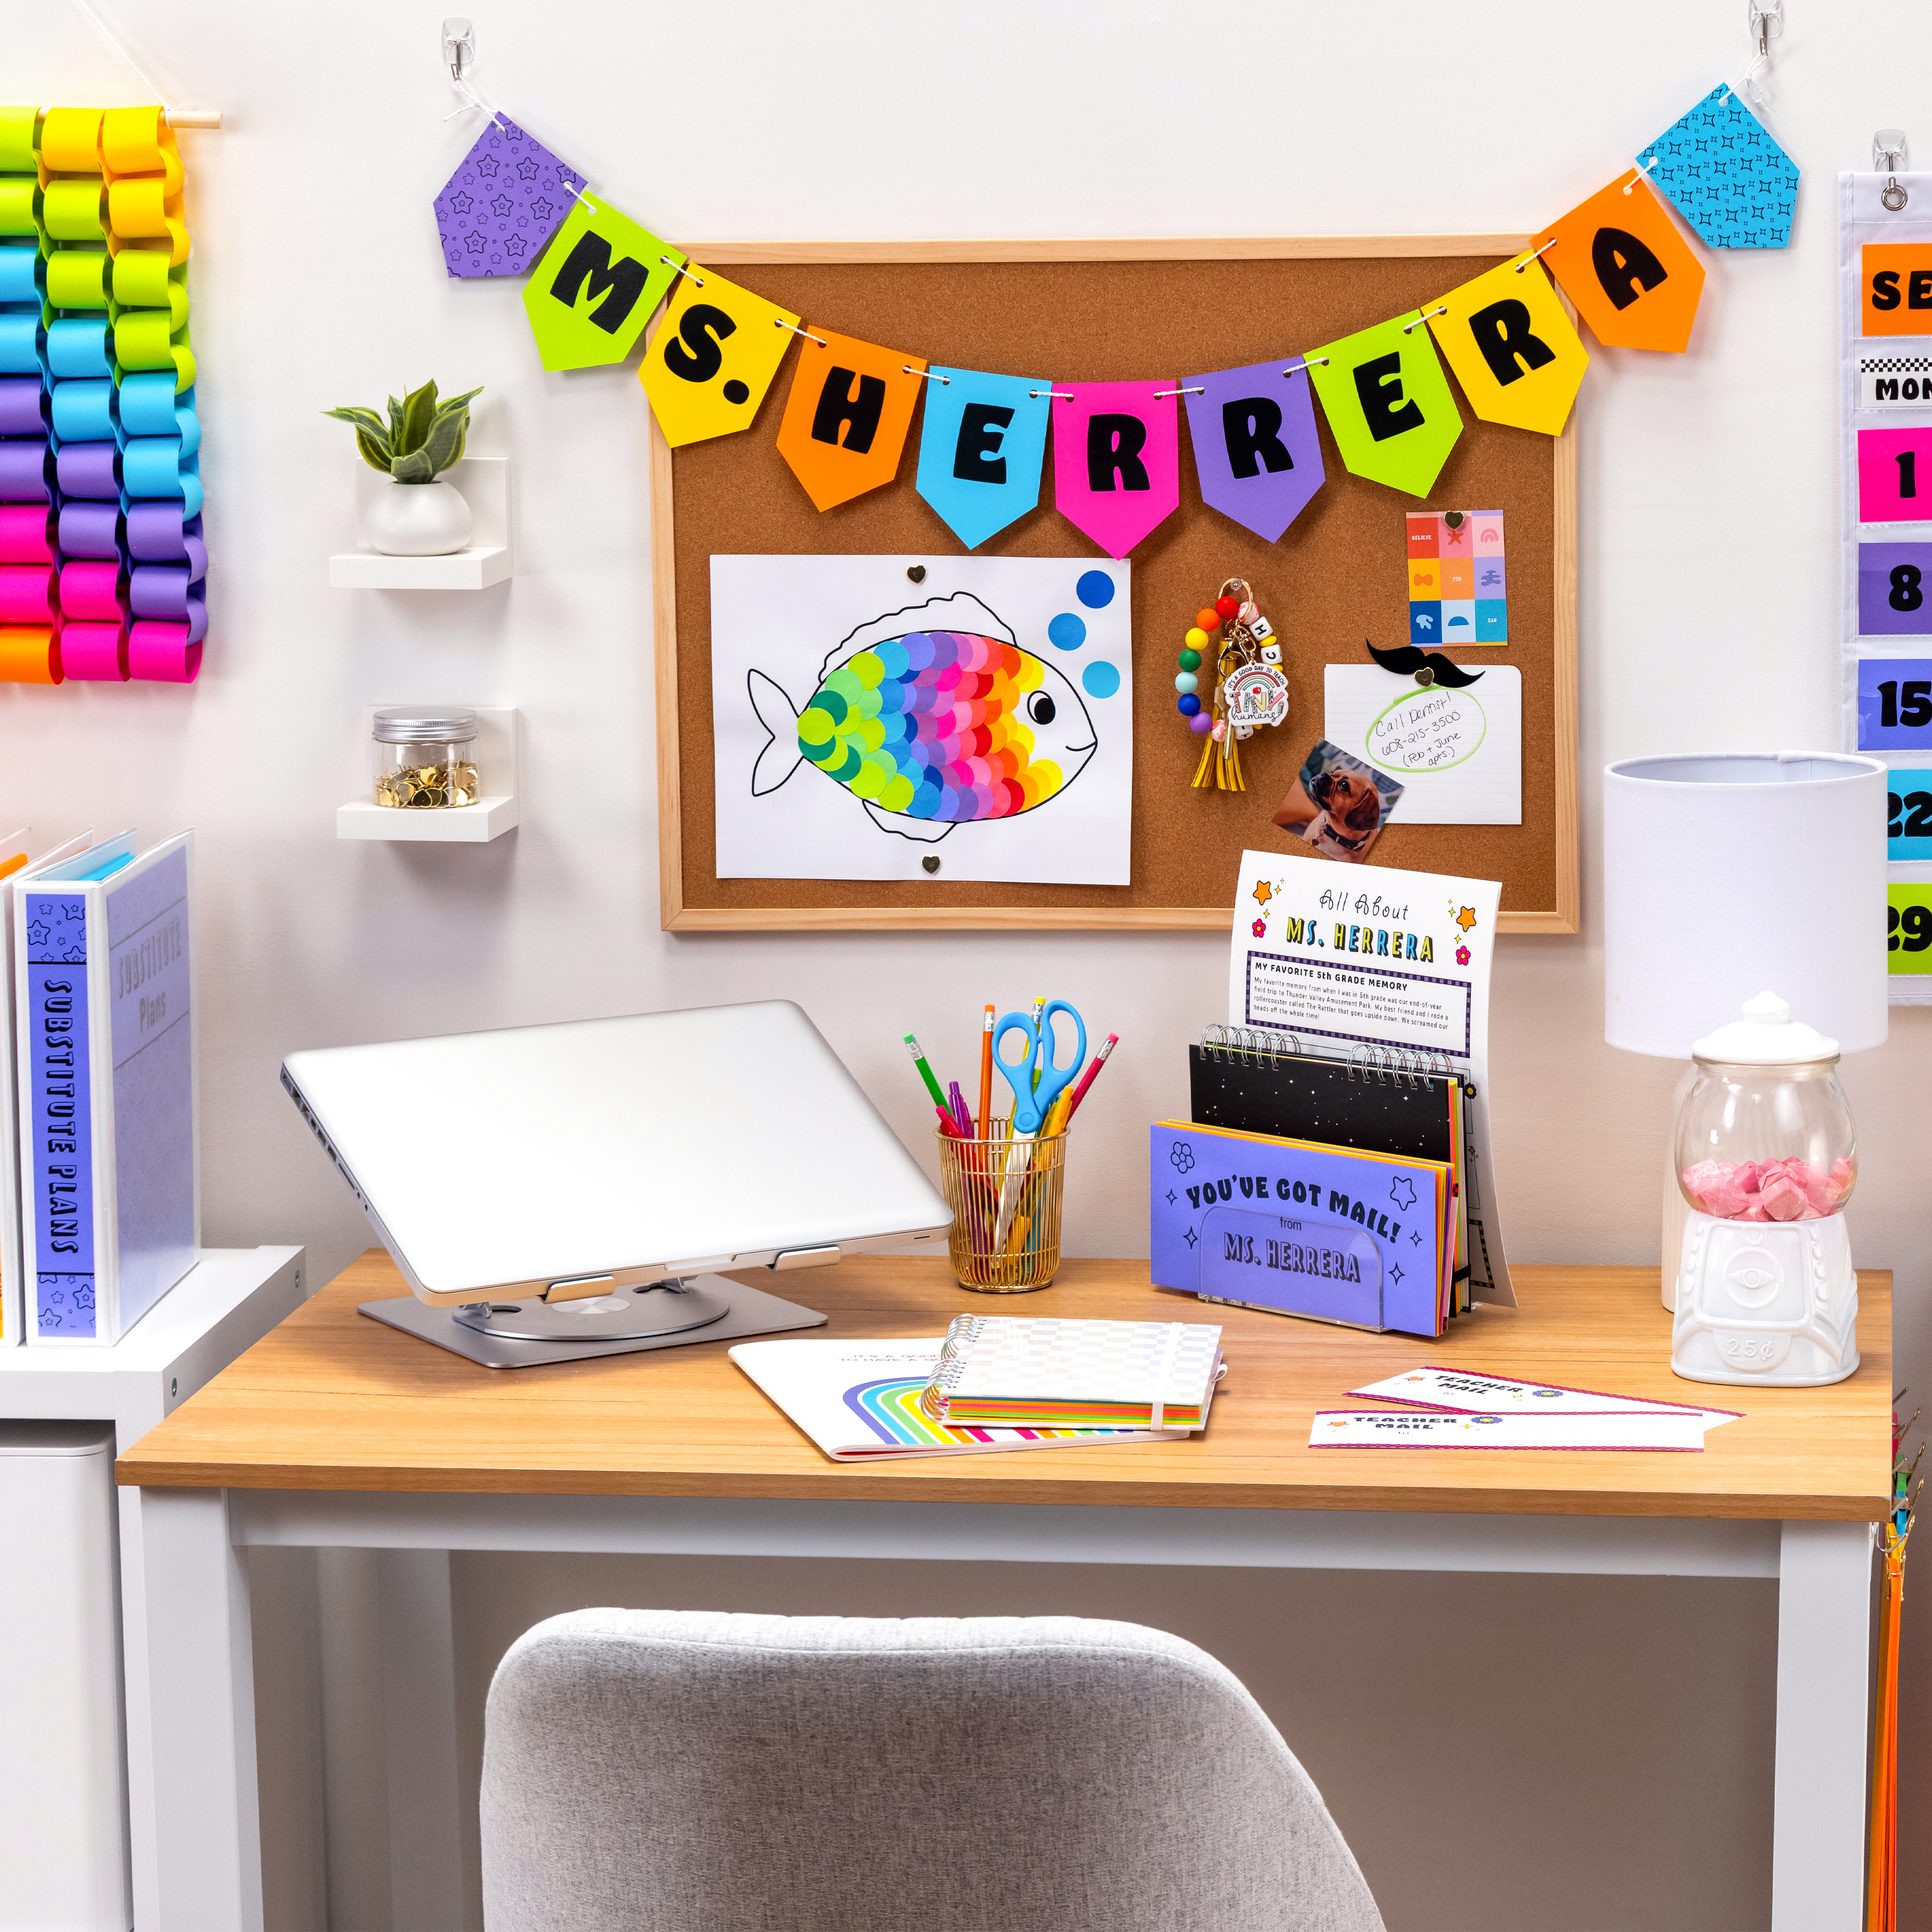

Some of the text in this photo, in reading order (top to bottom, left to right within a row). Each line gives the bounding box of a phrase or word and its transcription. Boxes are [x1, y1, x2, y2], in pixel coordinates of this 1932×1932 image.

[549, 226, 1668, 491] MS. HERRERA
[1895, 451, 1917, 498] 1
[1889, 565, 1923, 612] 8
[1238, 667, 1253, 676] GOOD
[1273, 670, 1285, 685] TEACH
[1229, 689, 1285, 714] TINY
[1231, 705, 1277, 722] humans
[1877, 681, 1932, 727] 15
[1376, 713, 1405, 737] Call
[1382, 711, 1461, 756] 608-215-3500
[1403, 752, 1425, 768] (Feb
[1434, 732, 1461, 748] June
[1428, 746, 1455, 766] apts.)
[1320, 889, 1408, 920] All About
[1286, 916, 1434, 963] MS. HERRERA
[1255, 962, 1408, 991] MY FAVORITE 5th GRADE MEMORY
[1264, 978, 1285, 987] favorite
[1286, 982, 1307, 991] memory
[1409, 1001, 1442, 1010] end-of-year
[1286, 990, 1307, 999] Thunder
[1309, 994, 1325, 1003] Valley
[1327, 996, 1358, 1007] Amusement
[1397, 1007, 1414, 1016] friend
[140, 991, 166, 1034] Plans
[1254, 996, 1287, 1005] rollercoaster
[1289, 1000, 1305, 1009] called
[1318, 1004, 1336, 1013] Rattler
[1338, 1007, 1349, 1015] that
[1383, 1014, 1399, 1023] down.
[1411, 1019, 1437, 1028] screamed
[44, 980, 79, 1255] SUBSTITUTE PLANS
[1186, 1173, 1401, 1244] YOU'VE GOT MAIL!
[1279, 1216, 1302, 1231] from
[1224, 1232, 1361, 1283] MS. HERRERA
[1727, 1338, 1774, 1362] 25¢
[1434, 1375, 1524, 1393] TEACHER
[1437, 1383, 1489, 1394] MAIL
